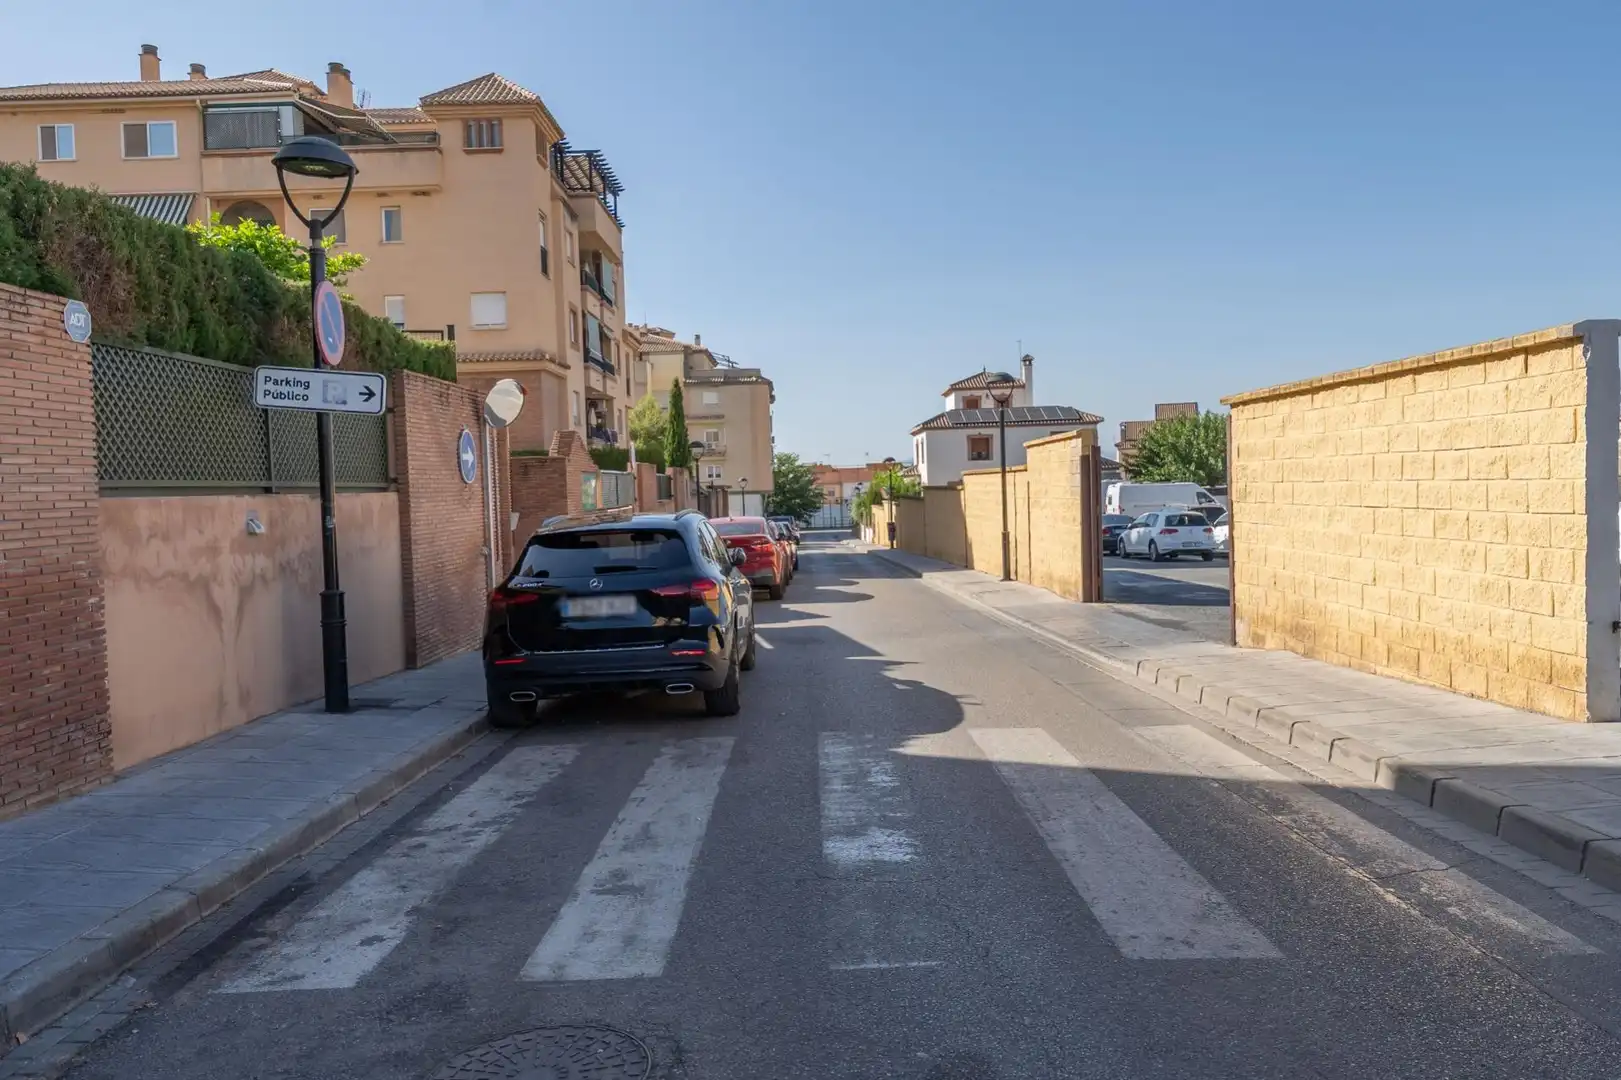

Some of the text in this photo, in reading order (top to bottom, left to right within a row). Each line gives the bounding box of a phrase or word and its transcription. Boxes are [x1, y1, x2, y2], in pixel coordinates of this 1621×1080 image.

[70, 312, 86, 328] ADT
[264, 375, 310, 390] Parking
[263, 388, 309, 402] Público
